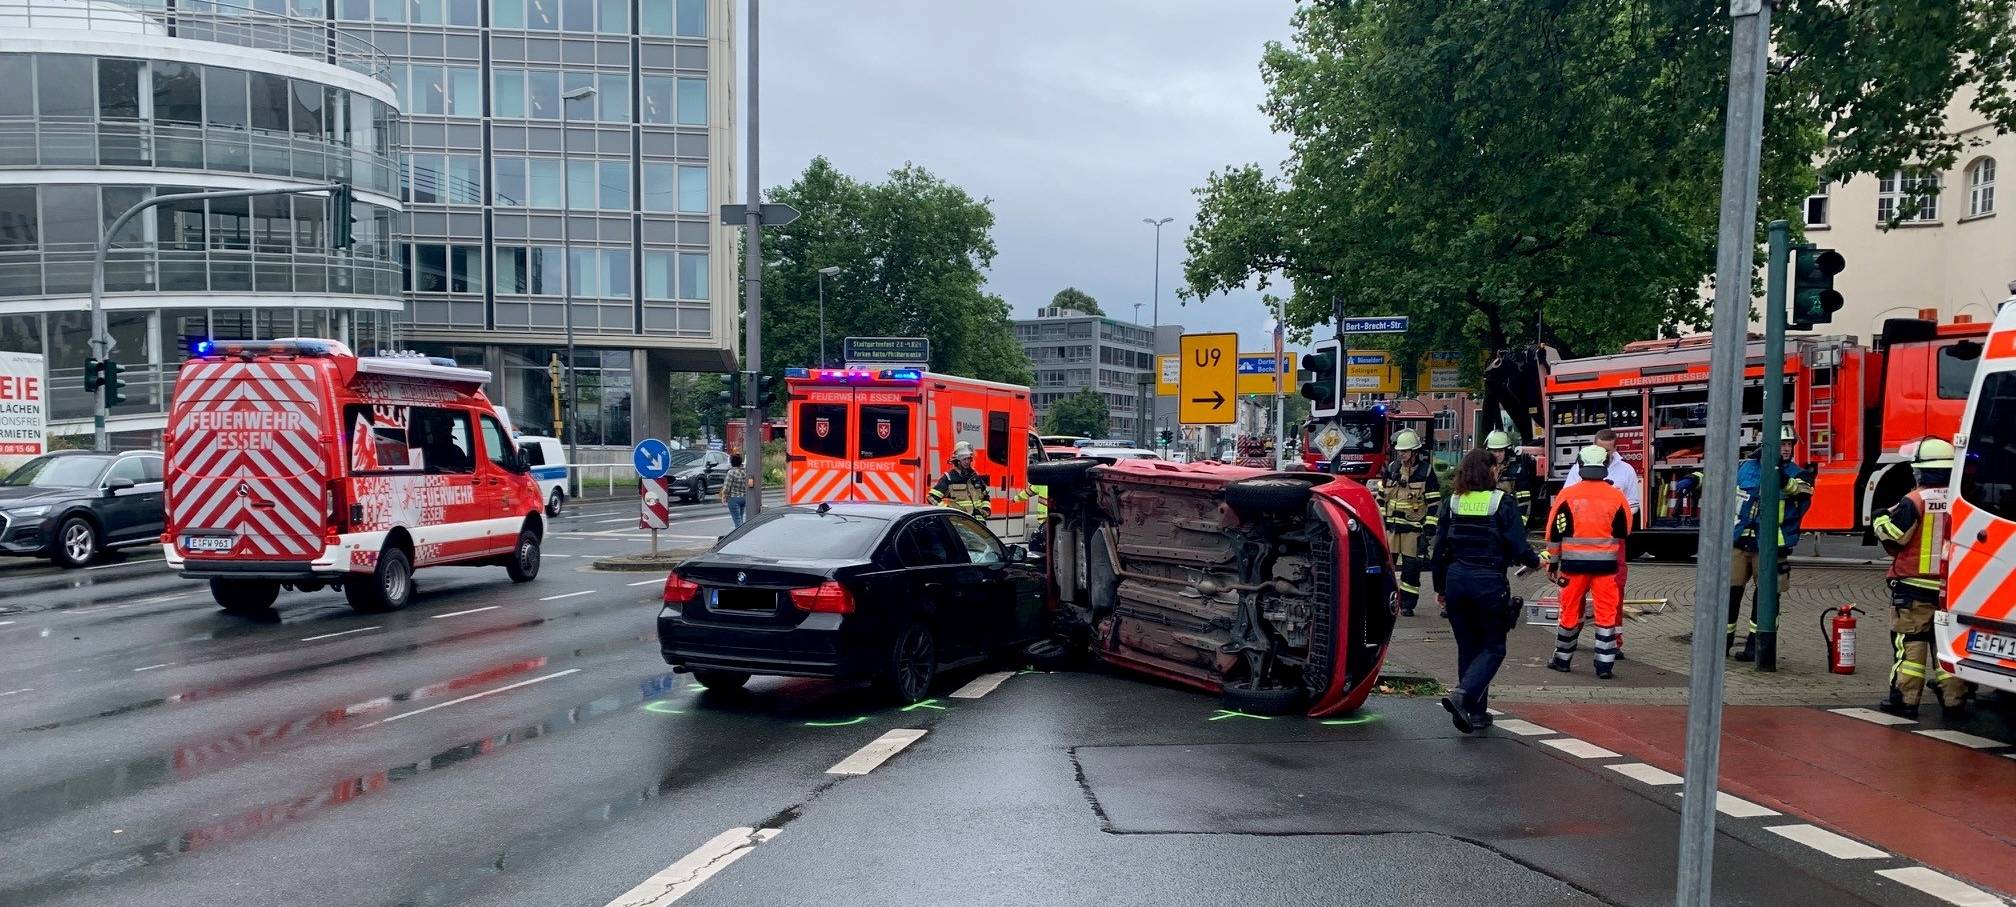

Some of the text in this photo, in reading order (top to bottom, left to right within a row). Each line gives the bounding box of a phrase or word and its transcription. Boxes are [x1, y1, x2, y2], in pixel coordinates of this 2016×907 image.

[1346, 320, 1403, 331] Bert-Brecht-Str.
[1195, 348, 1221, 368] U9
[1619, 371, 1711, 386] FEUERWEHR ESSEN
[811, 391, 901, 402] FEUERWEHR ESSEN
[189, 410, 301, 431] FEUERWEHR
[217, 431, 273, 450] ESSEN
[806, 460, 897, 472] RETTUNGSDIENST
[414, 485, 475, 508] FEUERWEHR
[420, 506, 445, 521] ESSEN
[1460, 502, 1489, 512] POLIZEI
[1928, 502, 1948, 511] ZUG
[214, 539, 229, 548] 961
[1974, 634, 1984, 649] E
[1988, 637, 2008, 653] FW
